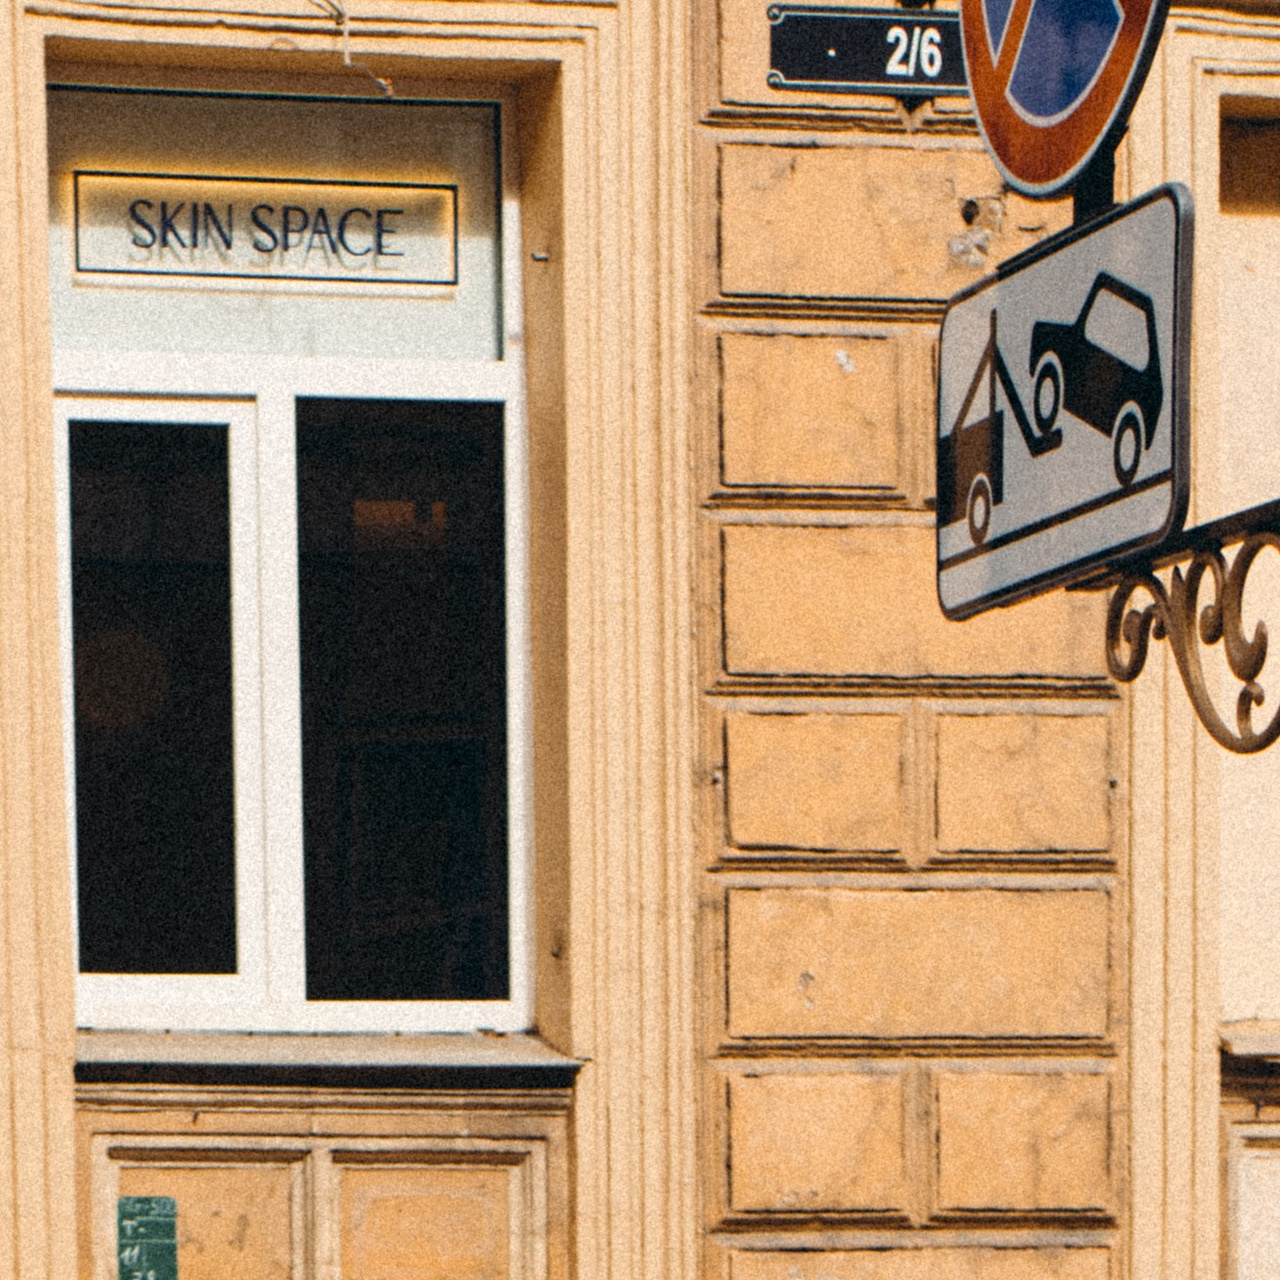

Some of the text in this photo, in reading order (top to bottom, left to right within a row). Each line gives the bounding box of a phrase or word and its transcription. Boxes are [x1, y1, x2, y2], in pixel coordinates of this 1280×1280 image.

[885, 26, 942, 78] 2/6
[129, 199, 405, 257] SKIN SPACE
